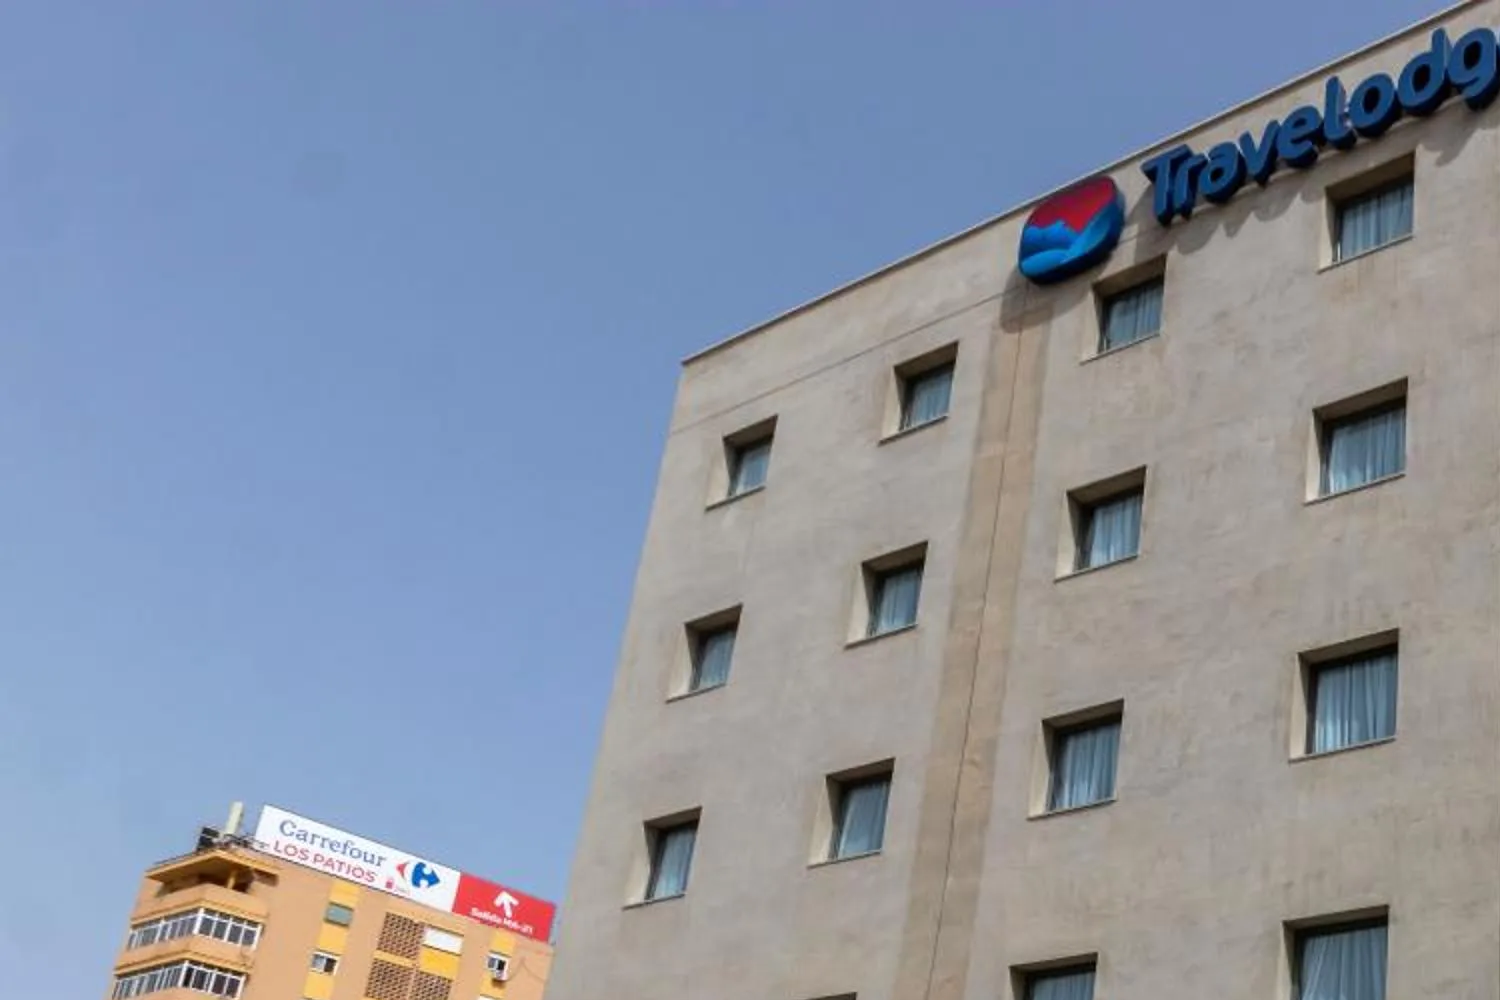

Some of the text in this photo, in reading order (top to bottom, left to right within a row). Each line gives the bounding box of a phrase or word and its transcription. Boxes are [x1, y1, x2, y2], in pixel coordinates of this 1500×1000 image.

[273, 839, 376, 884] LOS PATIOS
[279, 818, 388, 868] Carrefour
